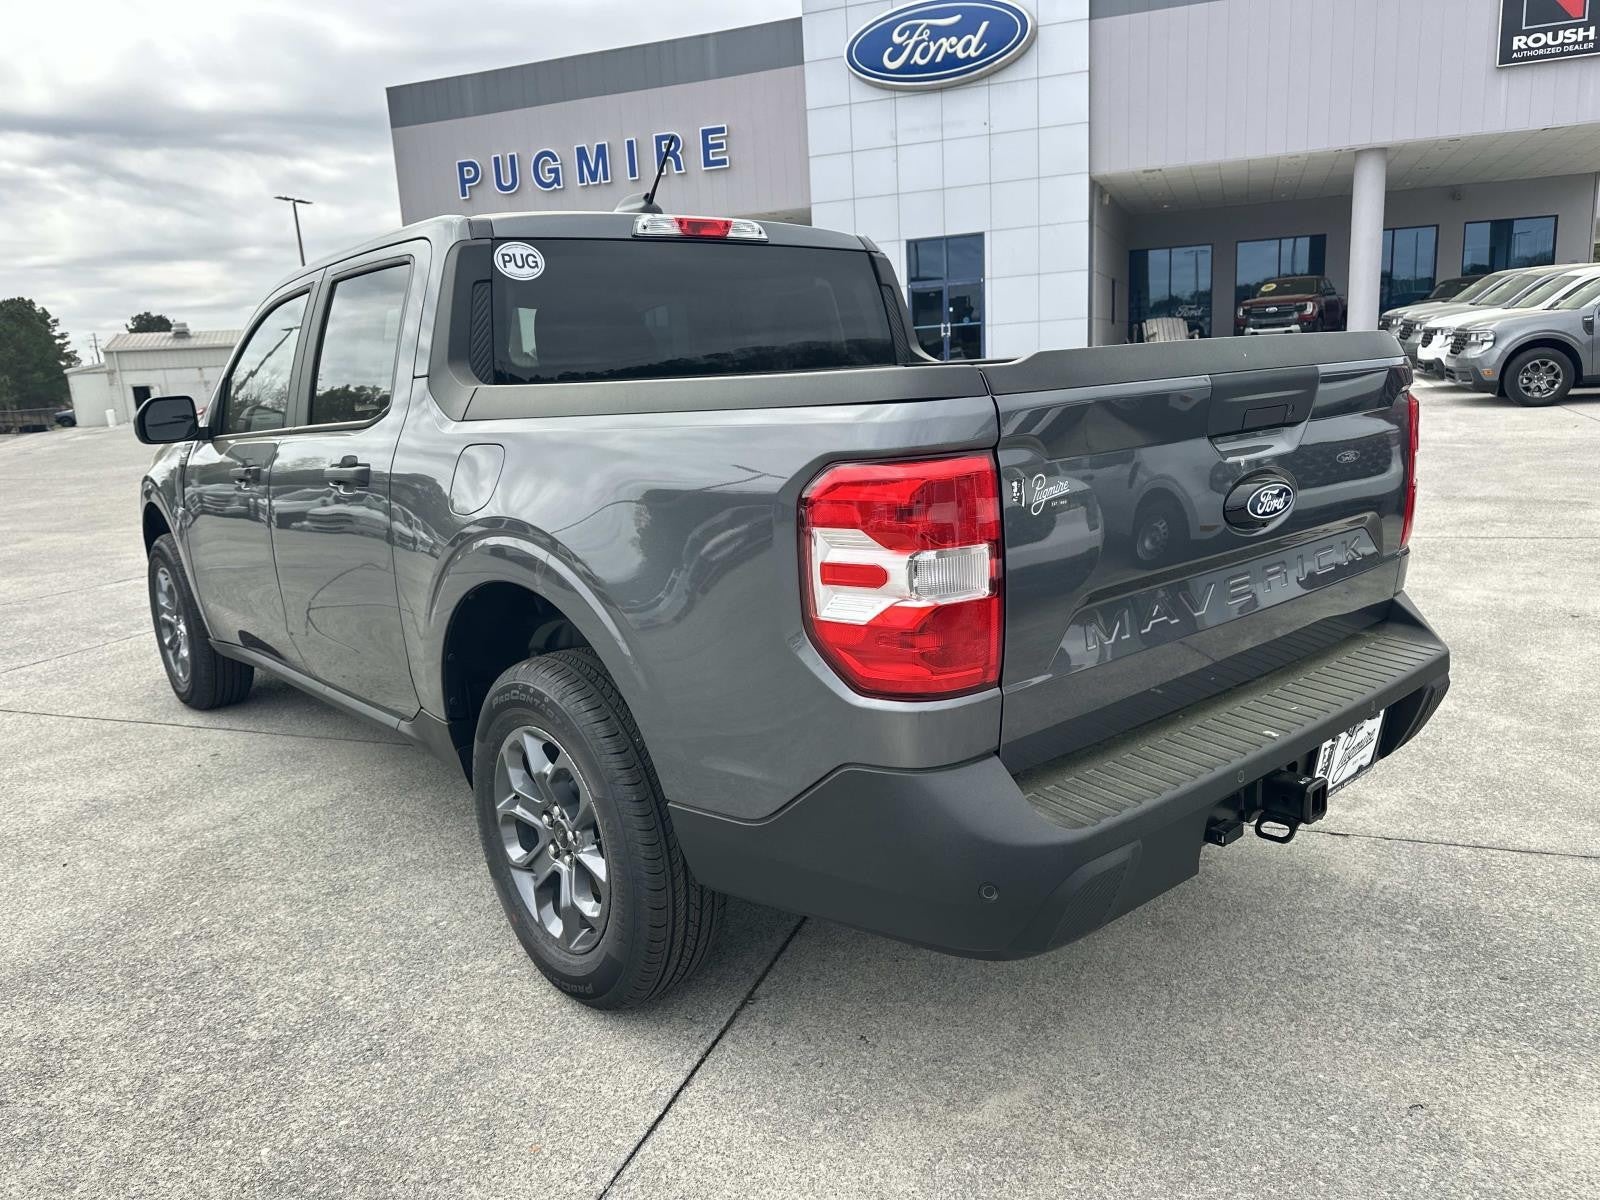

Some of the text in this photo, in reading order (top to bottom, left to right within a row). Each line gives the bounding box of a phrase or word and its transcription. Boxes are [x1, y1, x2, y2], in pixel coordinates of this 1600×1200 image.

[882, 14, 990, 70] Ford
[1512, 26, 1596, 51] ROUSH
[1512, 42, 1594, 59] AUTHORIZED DEALER
[456, 124, 730, 199] PUGMIRE
[501, 253, 539, 269] PUG
[1031, 474, 1070, 515] Pugmire
[1257, 488, 1285, 514] Ford
[1083, 535, 1363, 651] MAVERICK
